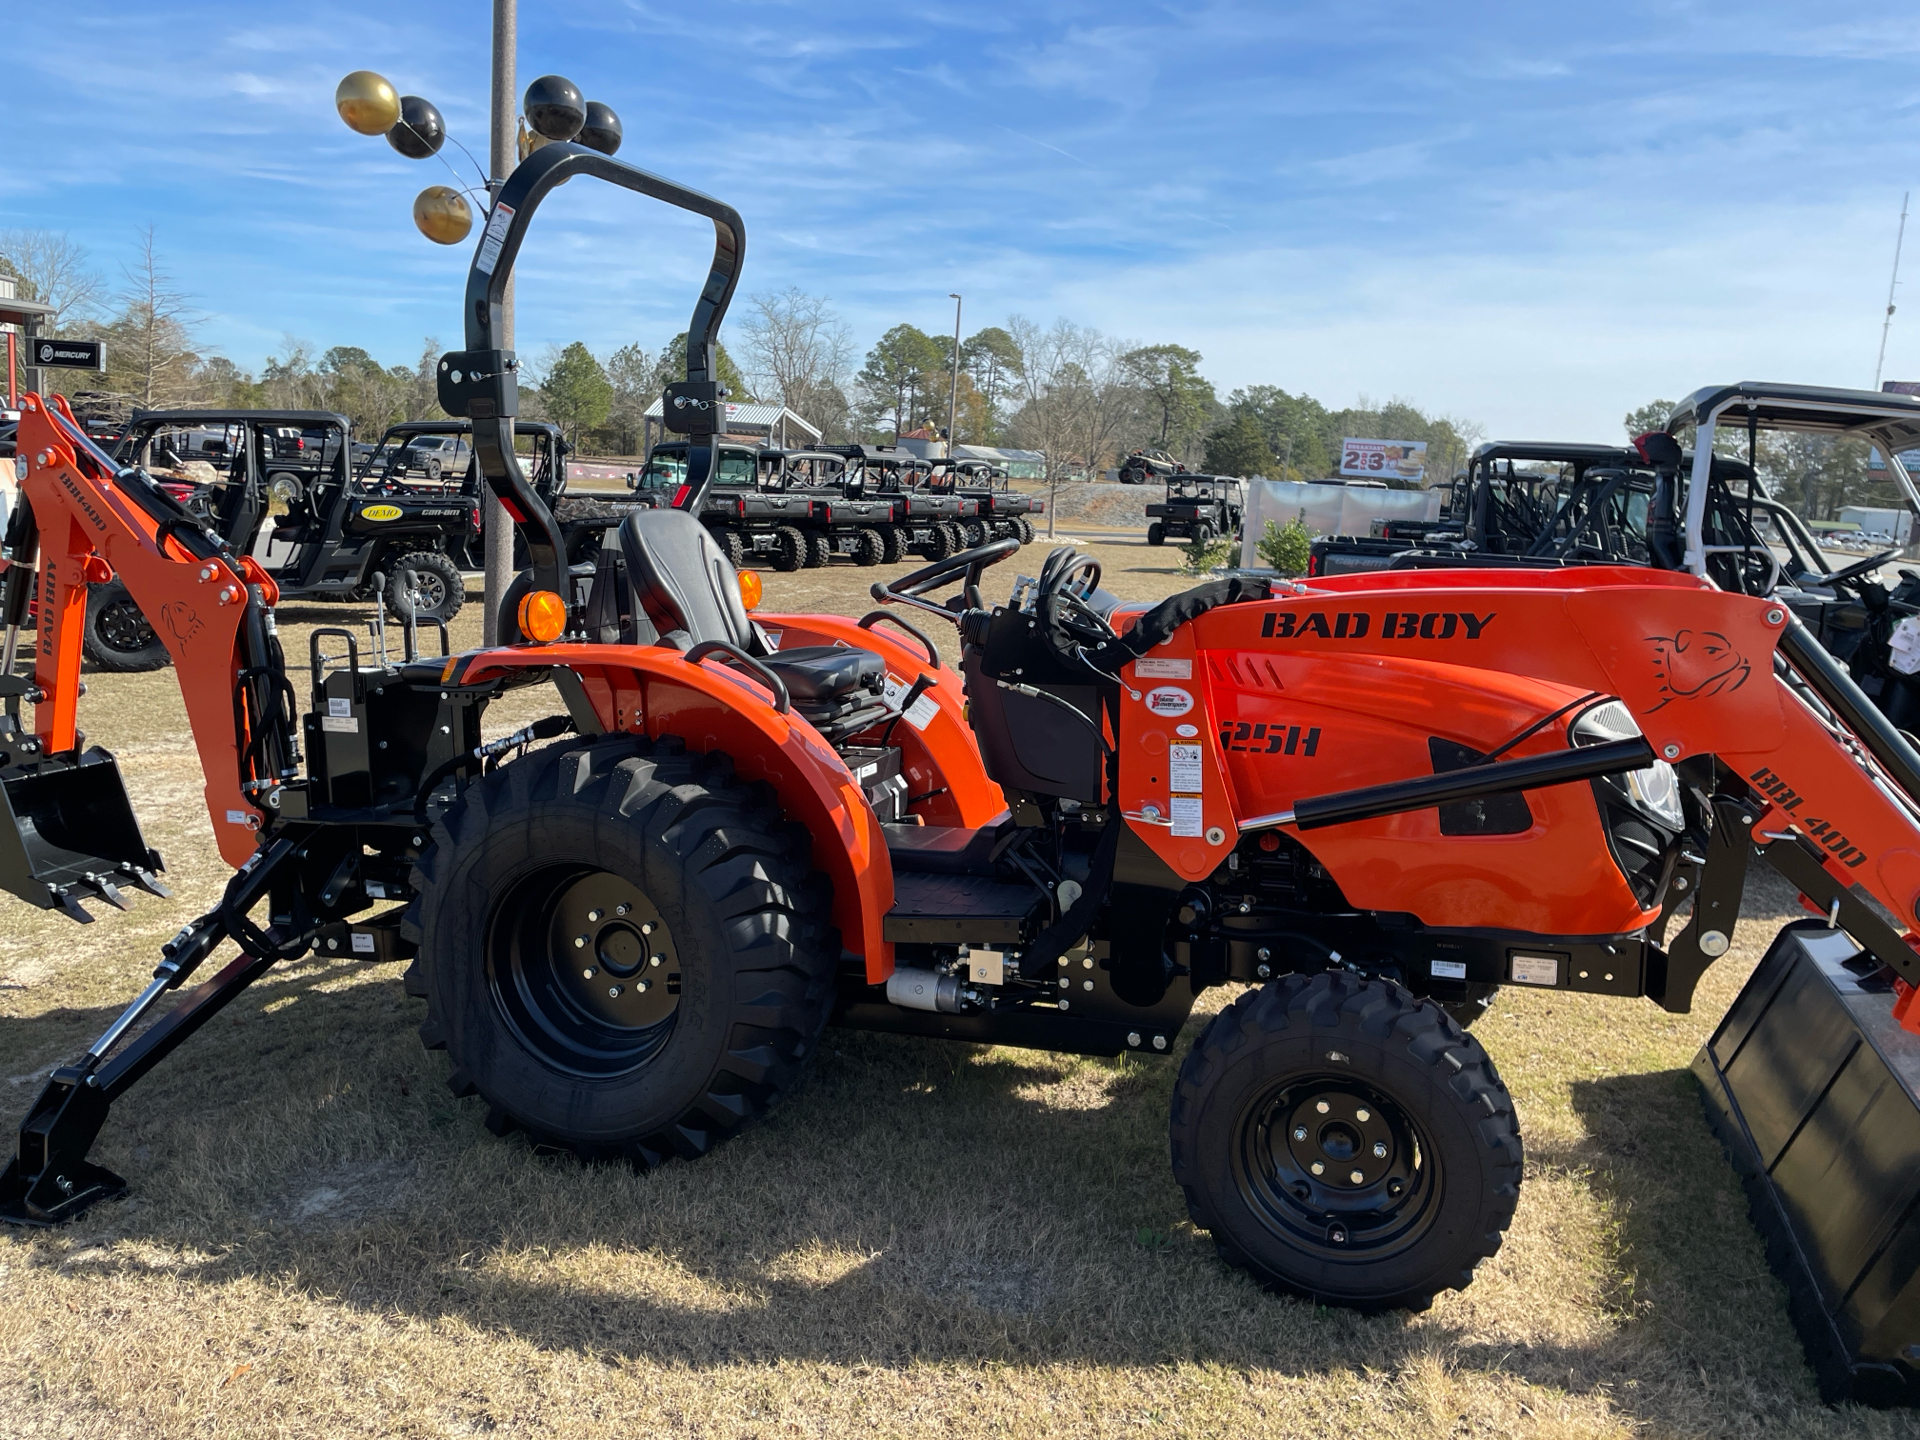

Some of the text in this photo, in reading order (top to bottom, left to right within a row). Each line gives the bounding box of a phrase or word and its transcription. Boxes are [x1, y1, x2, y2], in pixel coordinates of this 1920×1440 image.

[54, 350, 91, 360] MERCURY
[1347, 443, 1385, 451] BREAKFAST
[1344, 451, 1360, 470] 2
[59, 472, 107, 532] BBH400
[367, 509, 399, 517] DEMO
[42, 556, 57, 656] BAD BOY
[1261, 612, 1497, 639] BAD BOY
[1151, 693, 1175, 702] Volume
[1151, 701, 1188, 709] Powersports
[1749, 767, 1868, 869] BBL 400
